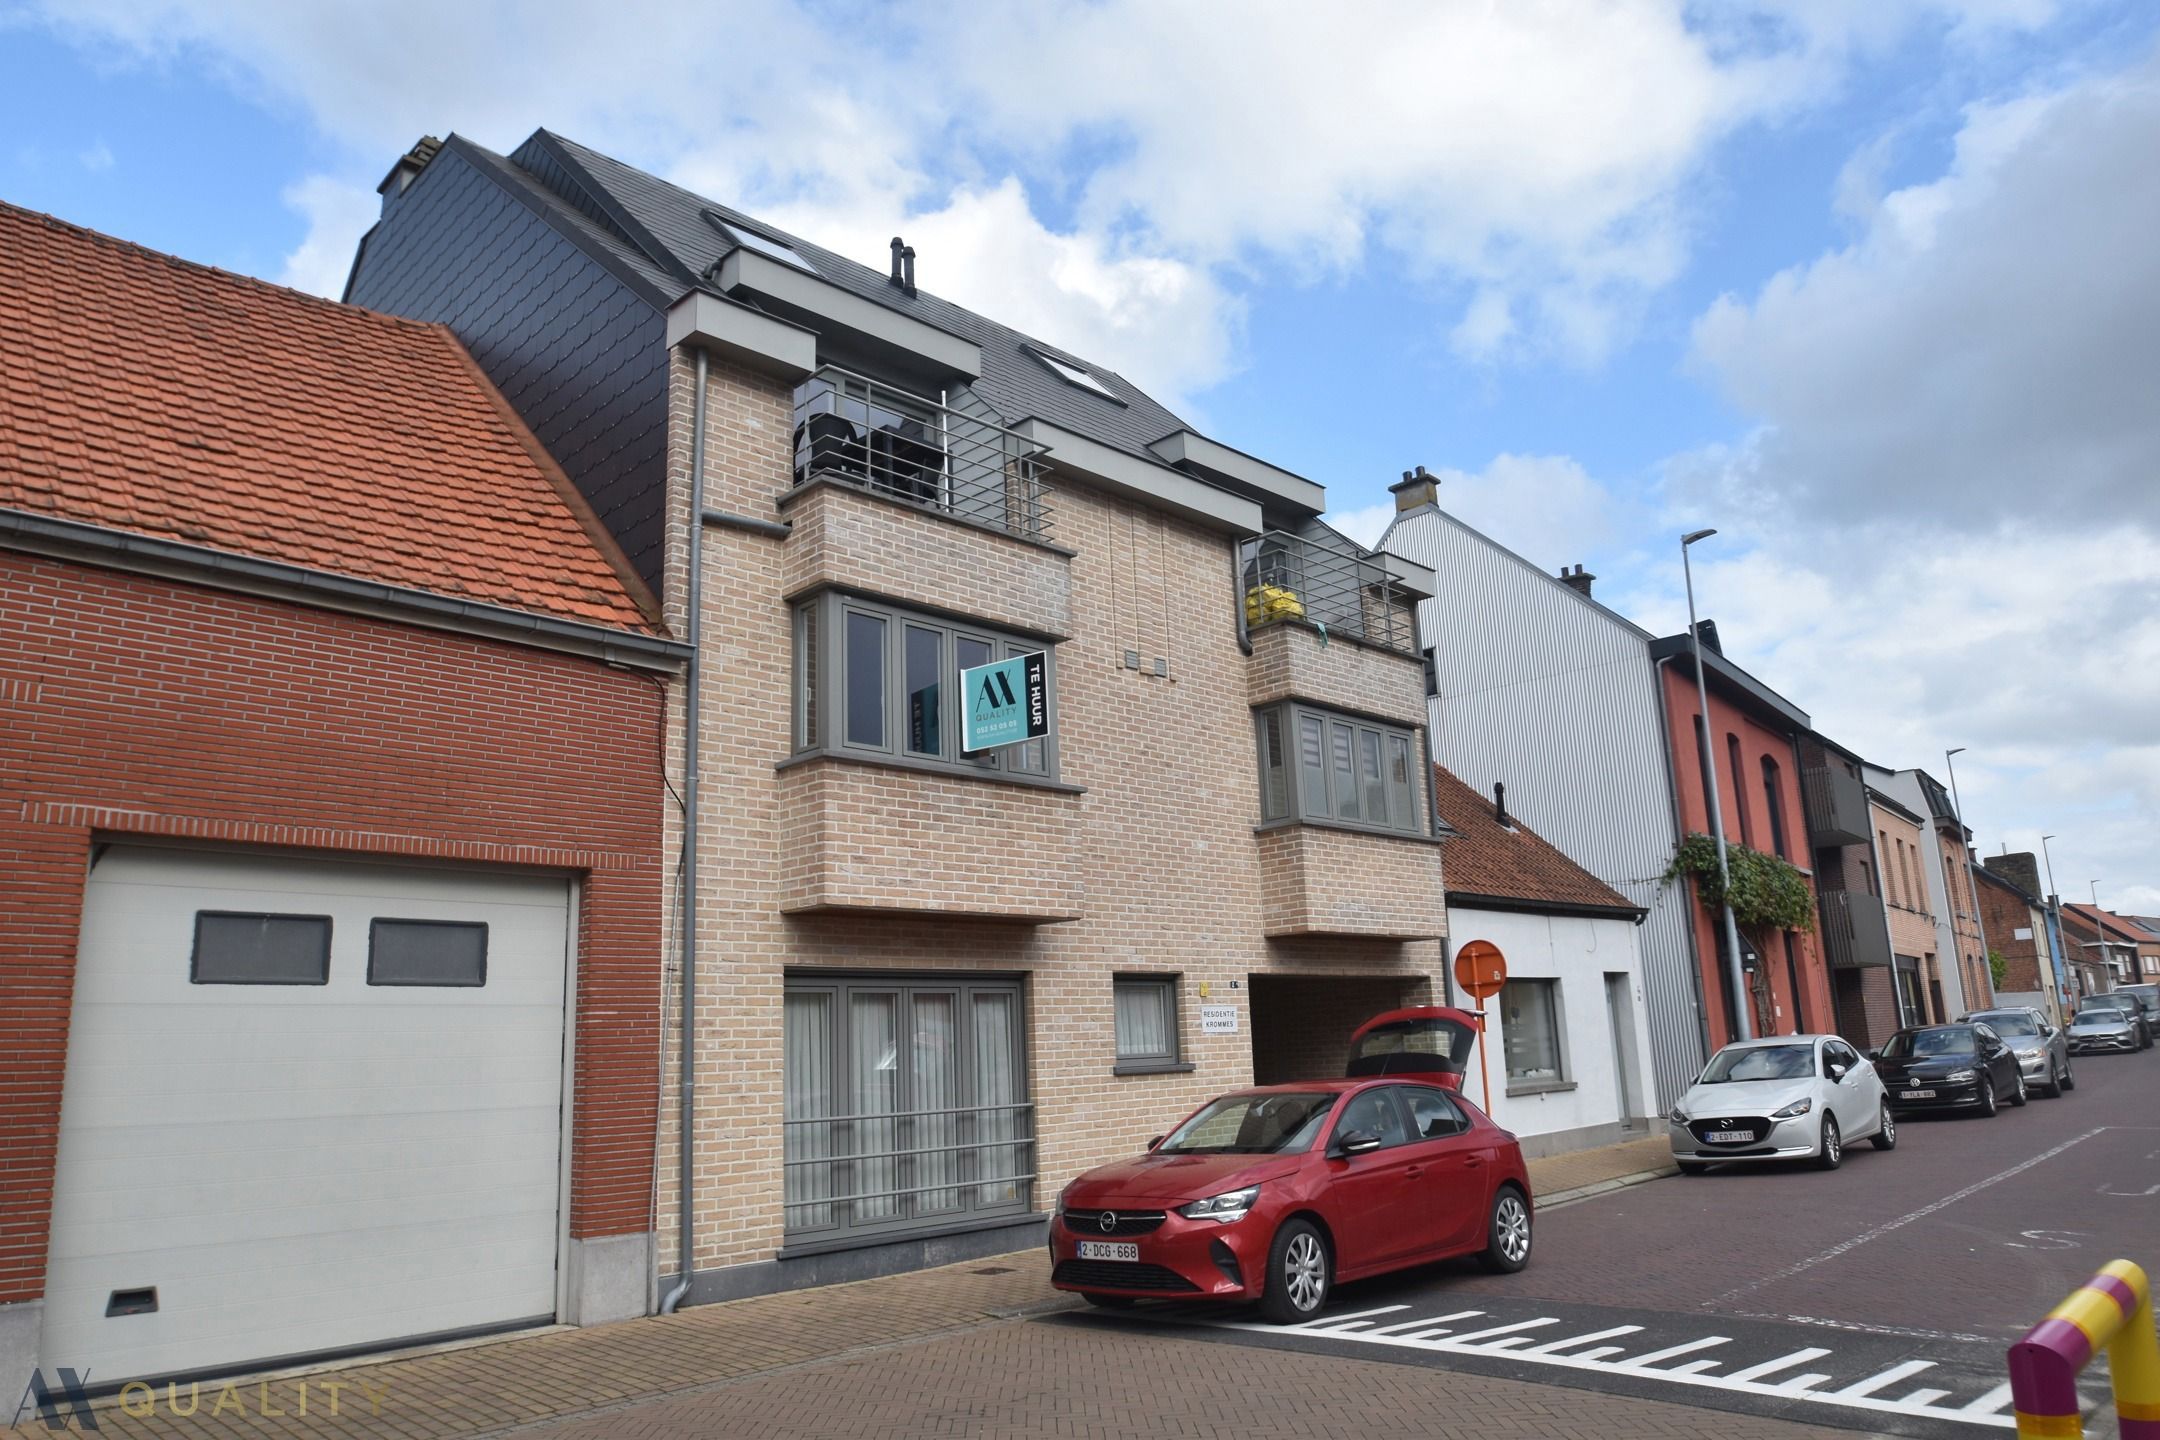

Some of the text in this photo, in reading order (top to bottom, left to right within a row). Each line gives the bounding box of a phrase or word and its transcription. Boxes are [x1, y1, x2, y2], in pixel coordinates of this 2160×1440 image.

[1030, 664, 1042, 727] TE HUUR
[975, 706, 1017, 722] QUALITY
[1203, 1010, 1235, 1018] RESIDENTIE
[1206, 1020, 1234, 1028] KROMMES
[1082, 1243, 1137, 1258] 2-DCG-668
